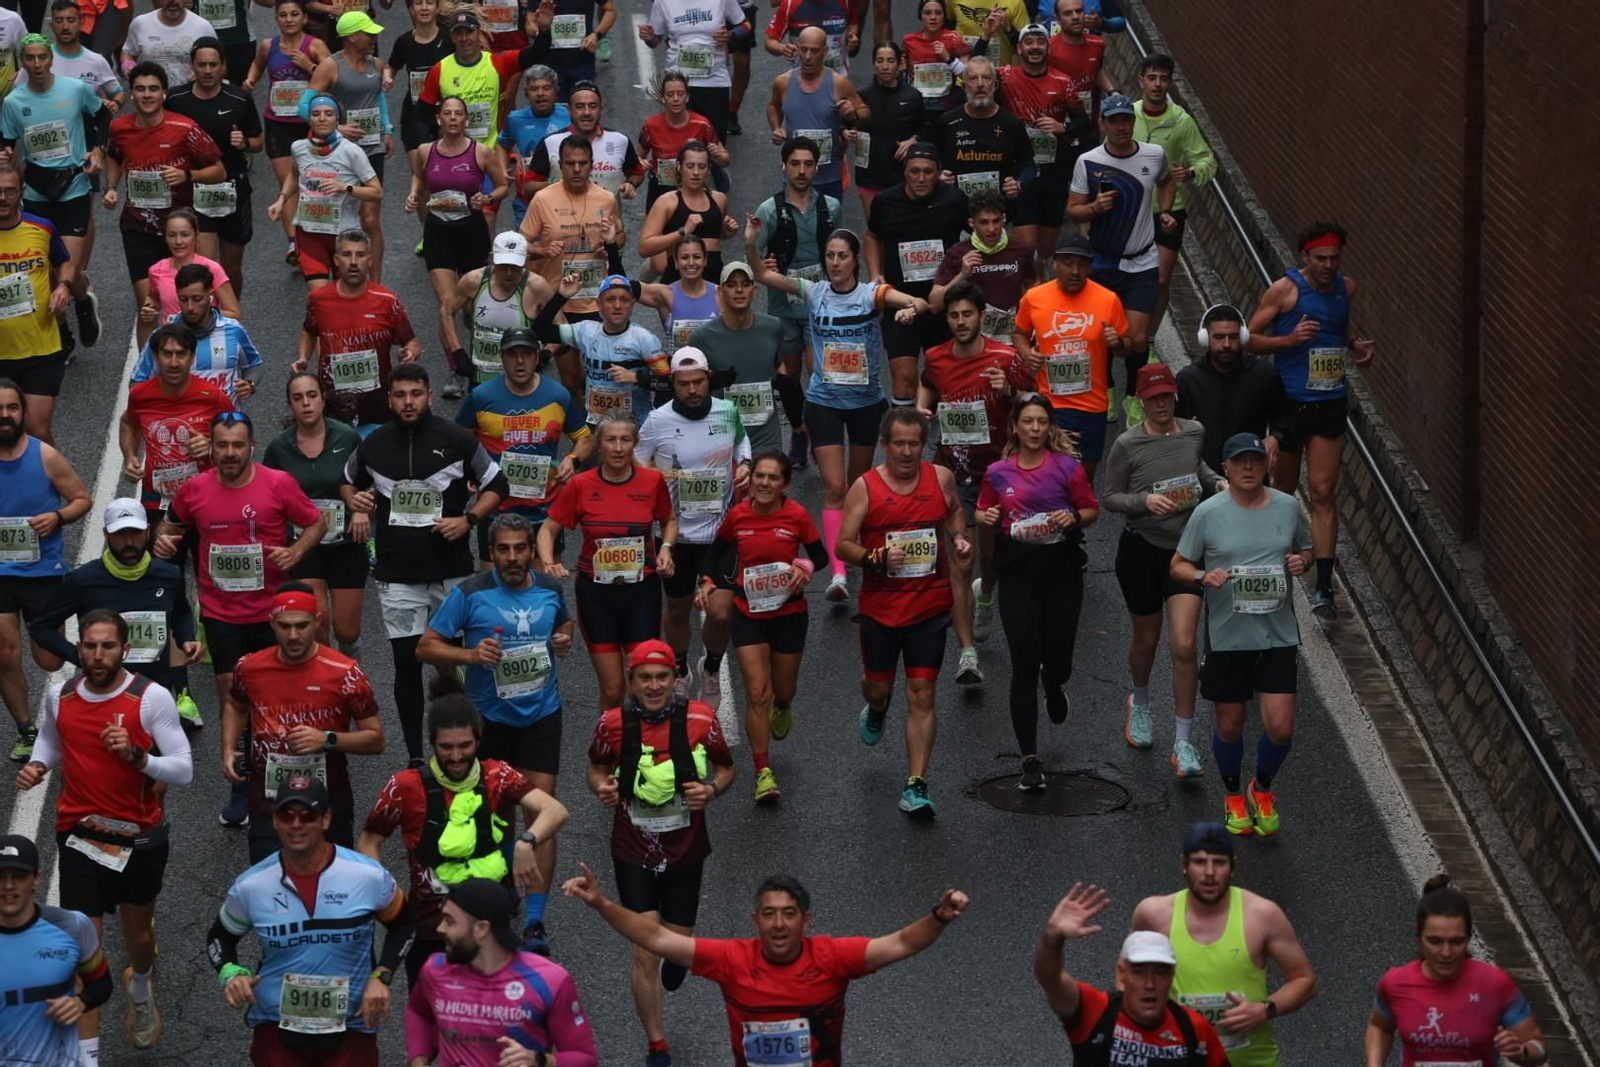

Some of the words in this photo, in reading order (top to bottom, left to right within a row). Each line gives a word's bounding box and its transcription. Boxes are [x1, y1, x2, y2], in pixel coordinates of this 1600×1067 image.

[554, 23, 578, 34] 8366
[682, 52, 706, 63] 8365
[469, 112, 483, 124] 25
[30, 130, 59, 147] 9902
[956, 149, 1003, 162] Asturias
[133, 179, 159, 193] 9581
[903, 250, 937, 264] 15622
[0, 257, 45, 274] nners
[829, 352, 859, 367] 5145
[335, 361, 371, 377] 10181
[1051, 363, 1081, 376] 7070
[593, 394, 621, 409] 5624
[732, 393, 761, 408] 7621
[503, 416, 541, 429] NEVER
[947, 412, 976, 427] 8289
[503, 430, 530, 444] GIVE
[532, 430, 547, 444] UP
[507, 463, 539, 480] 6703
[687, 479, 718, 494] 7078
[398, 491, 431, 506] 9776
[1, 529, 26, 544] 873
[216, 556, 251, 571] 9808
[599, 548, 637, 564] 10680
[748, 573, 788, 592] 16758
[1235, 576, 1278, 593] 10291
[128, 623, 153, 640] 114
[502, 657, 540, 677] 8902
[269, 931, 361, 949] ALCAUDETE
[290, 989, 331, 1008] 9118
[753, 1036, 794, 1055] 1576
